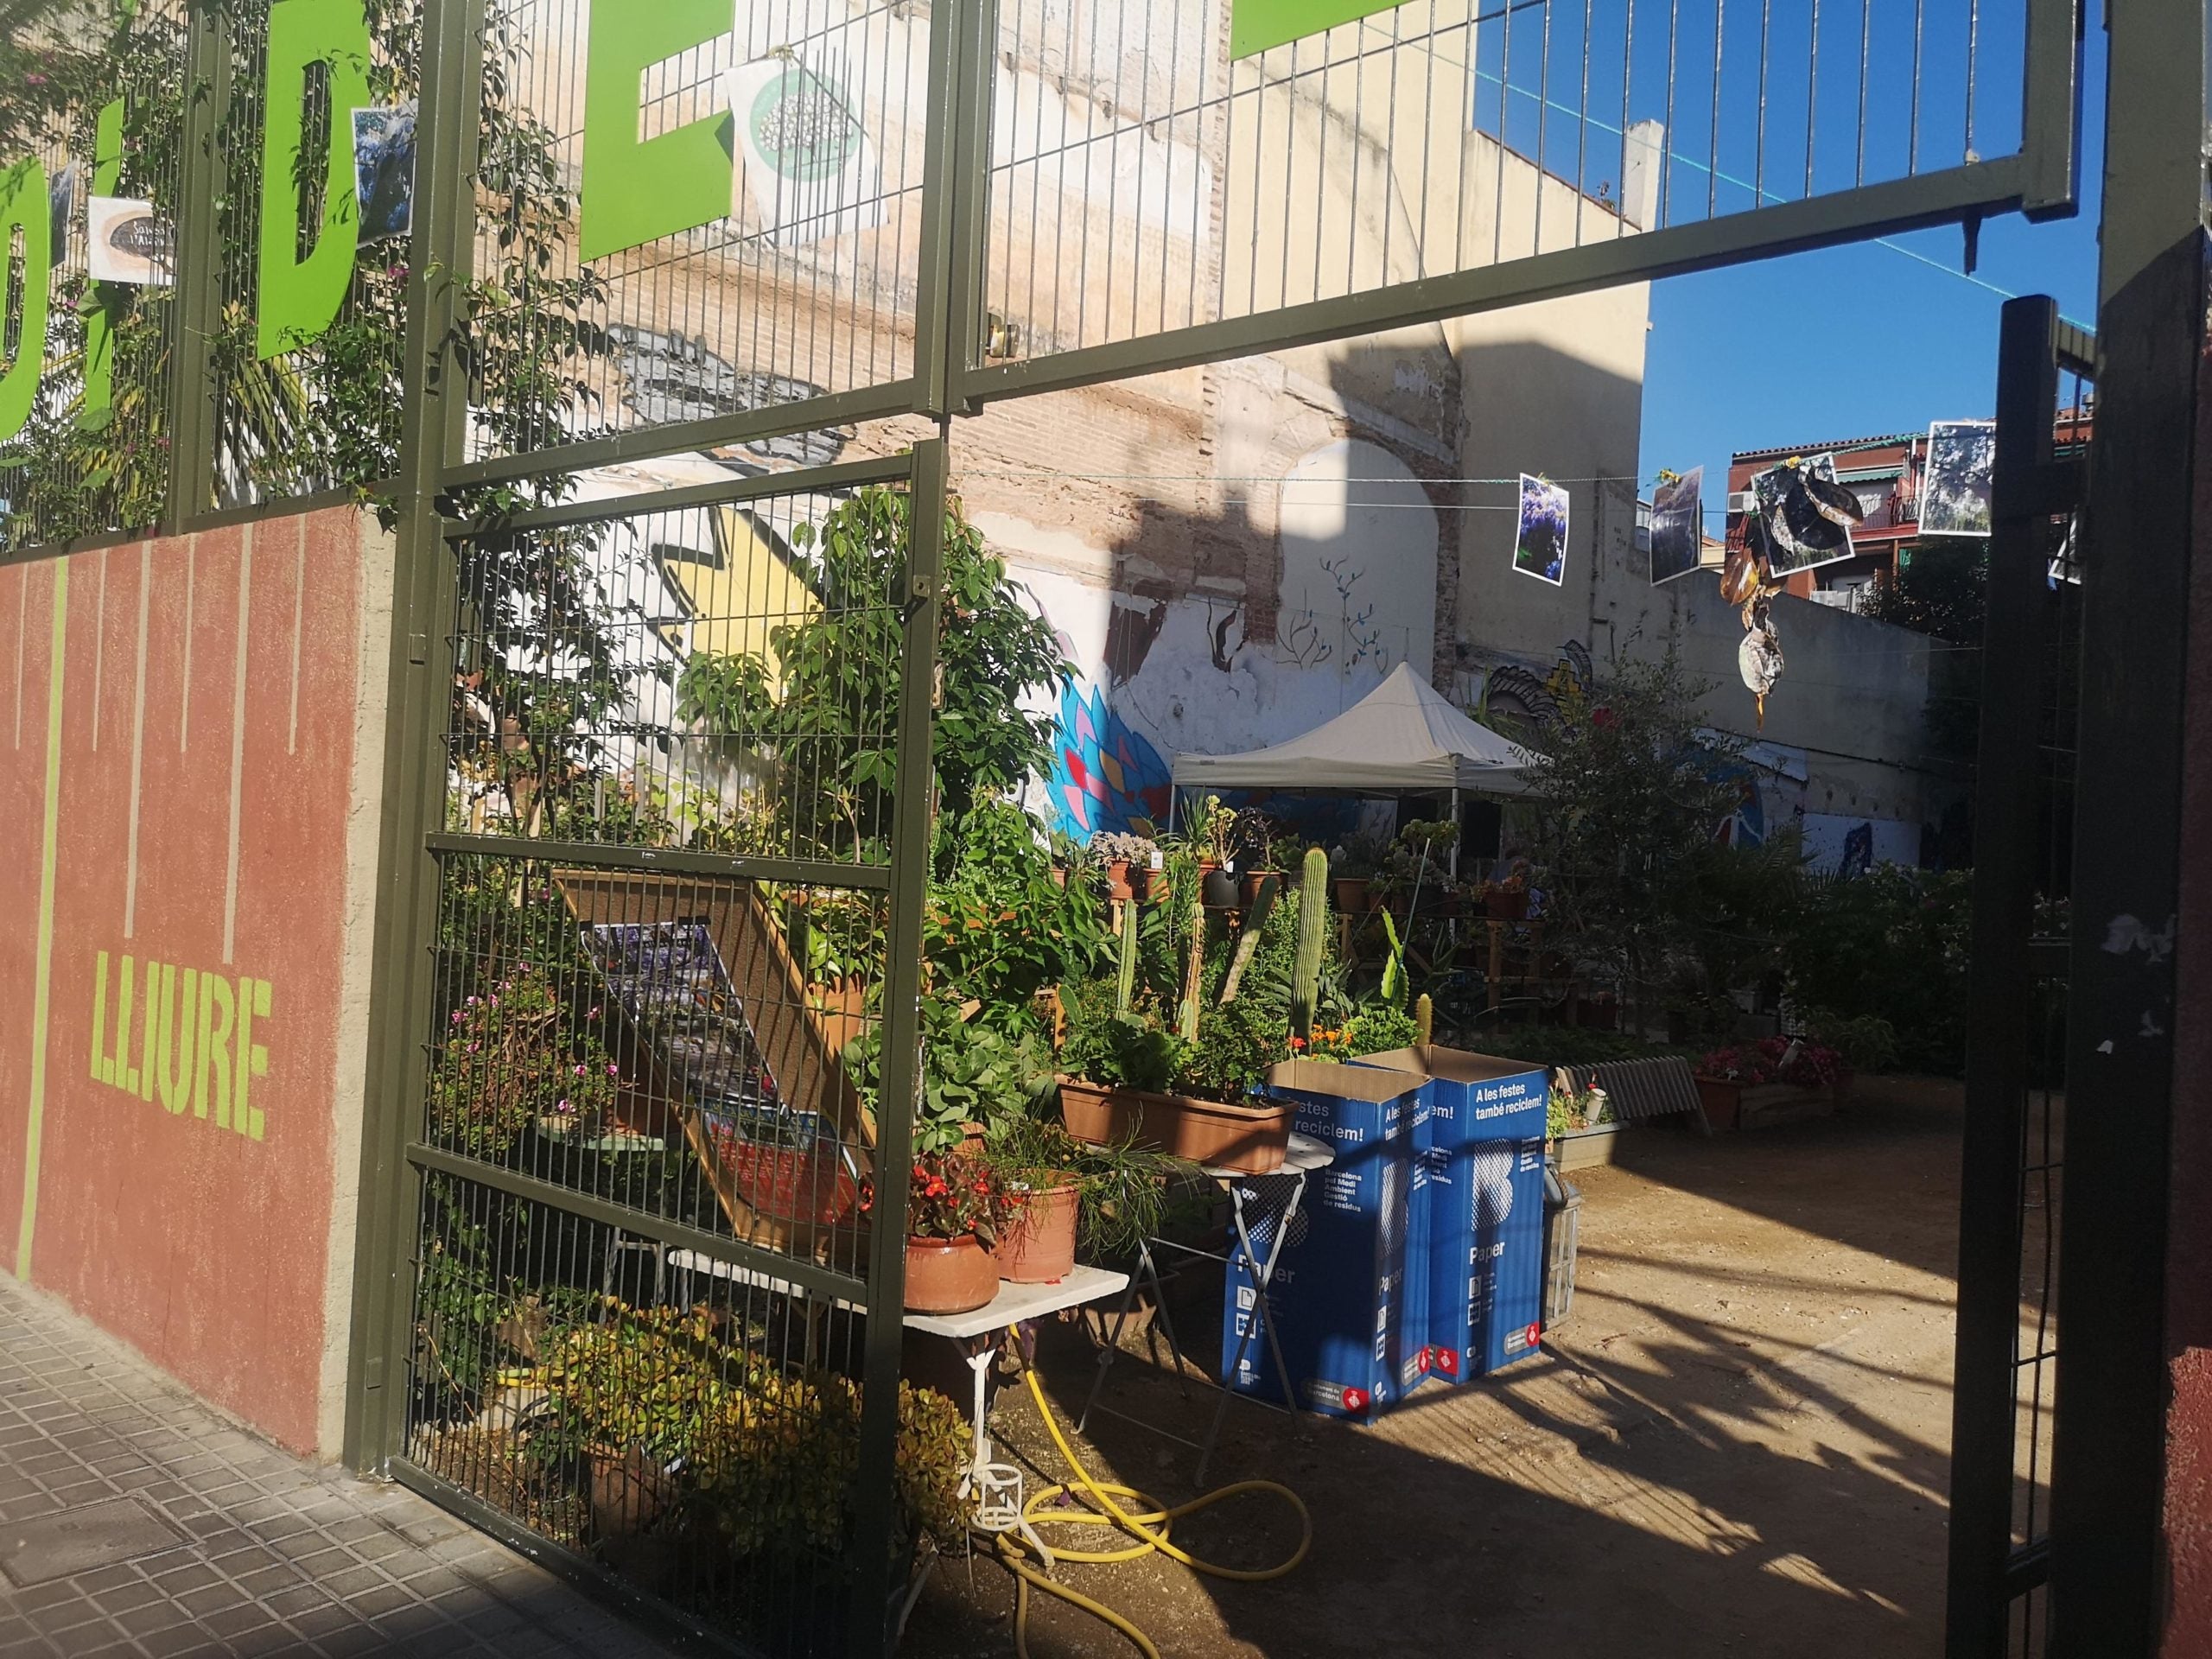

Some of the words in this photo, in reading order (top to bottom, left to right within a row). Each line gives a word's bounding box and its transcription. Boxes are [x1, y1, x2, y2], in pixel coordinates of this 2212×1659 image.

[91, 950, 272, 1141] LLIURE
[1476, 1089, 1484, 1103] A
[1484, 1088, 1498, 1102] les
[1499, 1084, 1526, 1099] festes
[1299, 1101, 1330, 1117] stes
[1385, 1108, 1391, 1123] A
[1391, 1106, 1401, 1121] les
[1476, 1103, 1504, 1120] també
[1505, 1094, 1542, 1115] reciclem!
[1295, 1120, 1363, 1142] reciclem!
[1469, 1242, 1505, 1265] Paper
[1379, 1268, 1403, 1295] Paper
